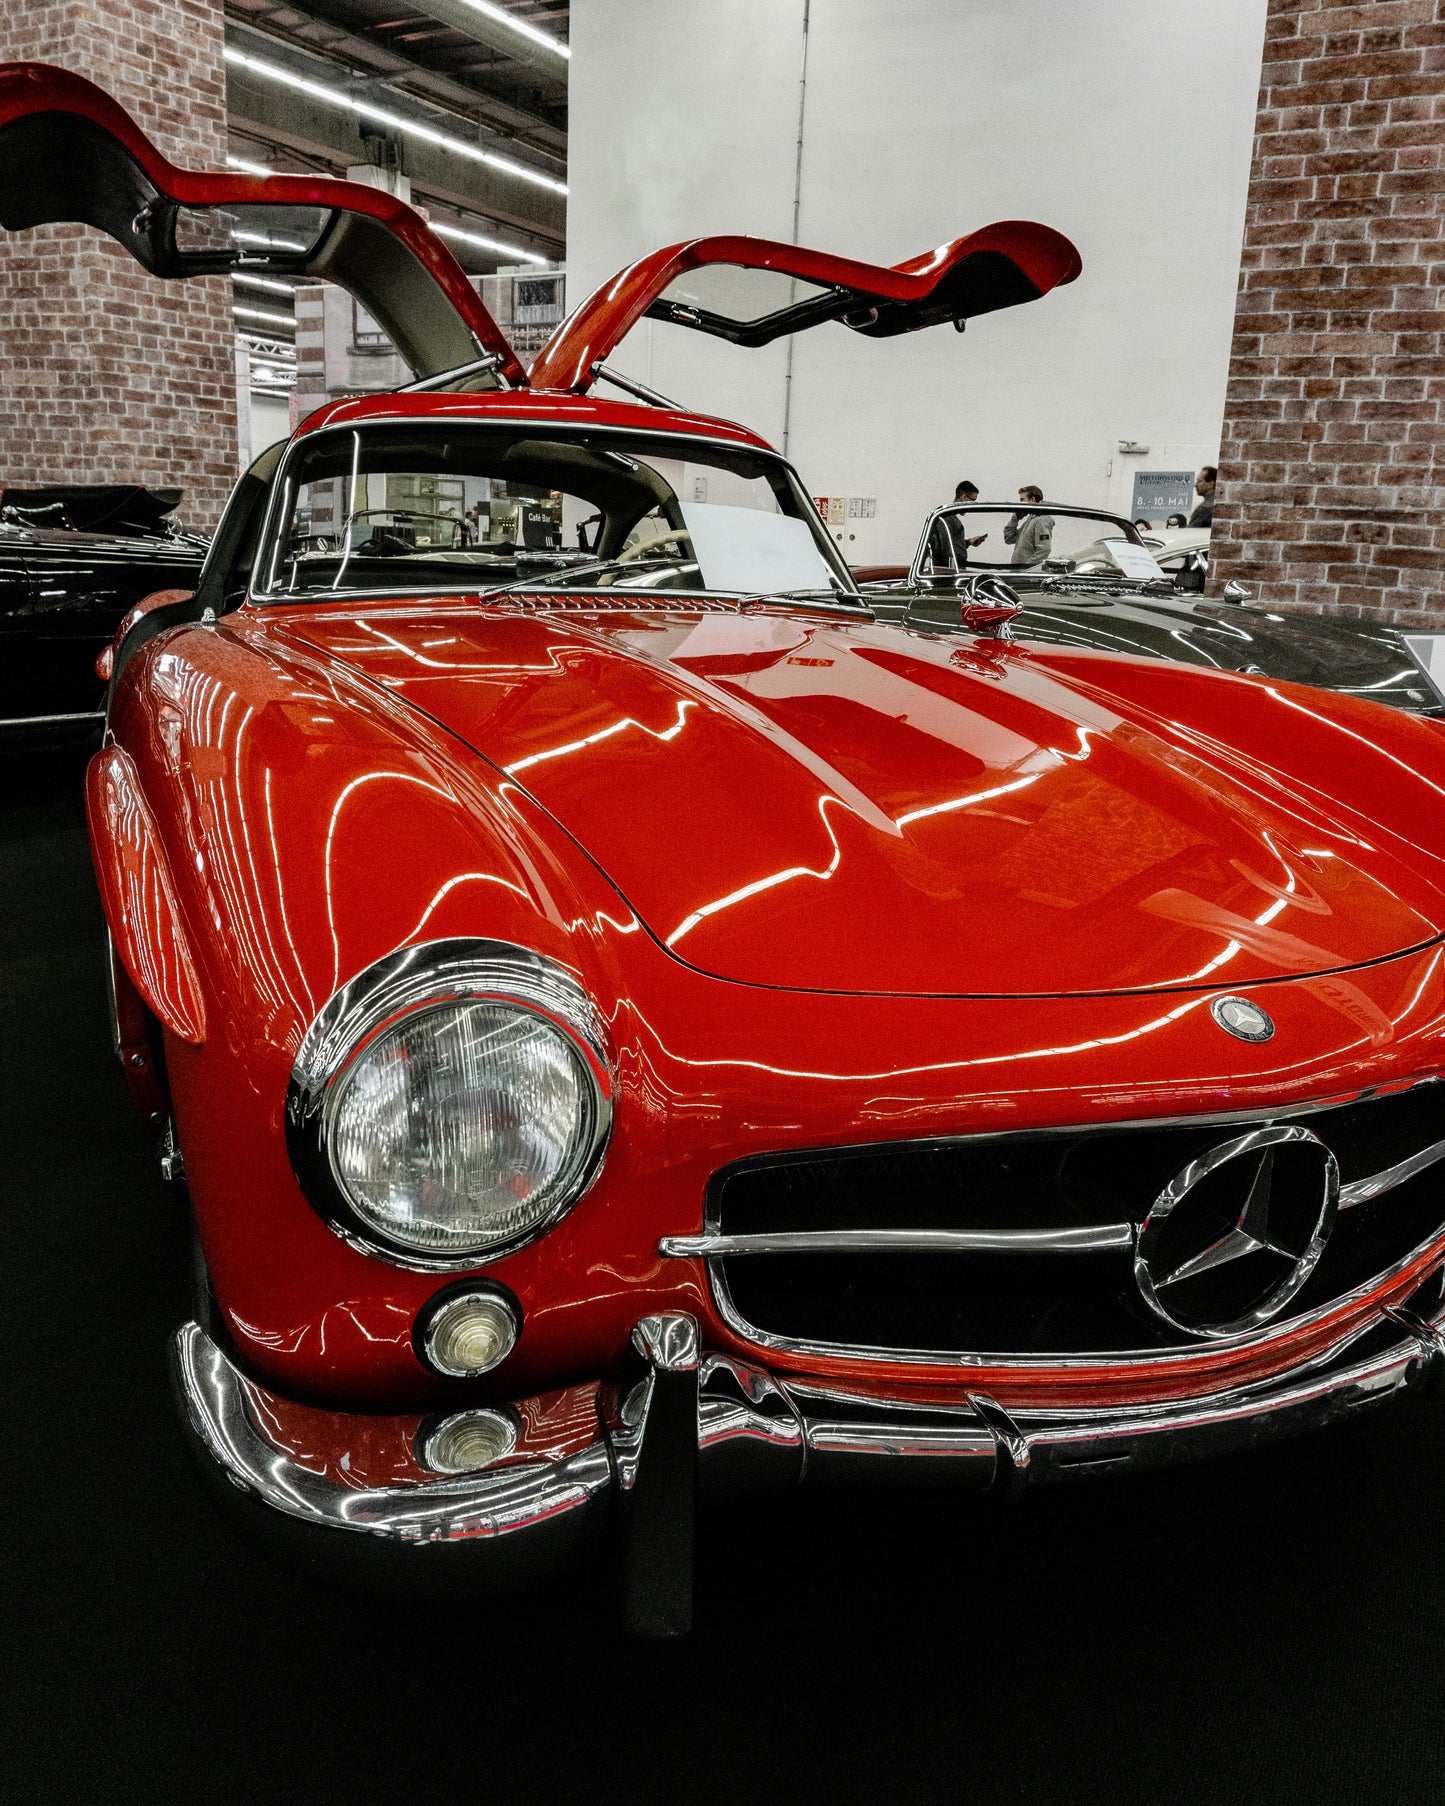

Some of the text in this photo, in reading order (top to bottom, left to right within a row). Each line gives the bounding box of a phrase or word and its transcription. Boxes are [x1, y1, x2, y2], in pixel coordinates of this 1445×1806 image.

[1137, 496, 1146, 506] 8.
[1154, 496, 1166, 506] 10.
[1168, 497, 1188, 506] MAI
[528, 512, 550, 522] Café Bar
[1248, 1032, 1270, 1040] BENZ
